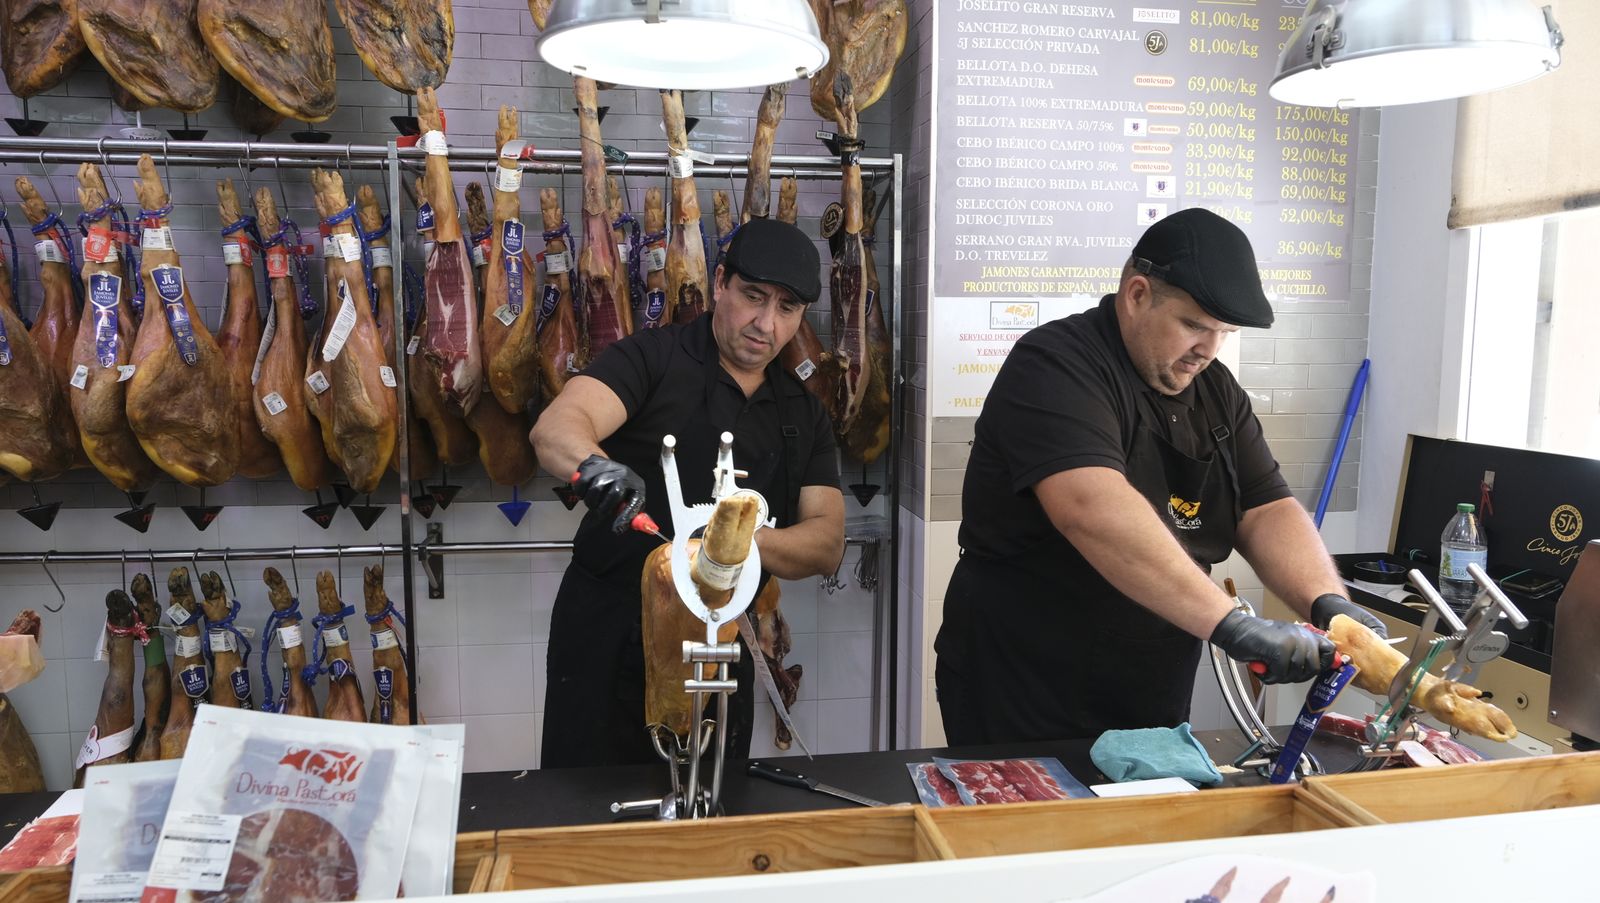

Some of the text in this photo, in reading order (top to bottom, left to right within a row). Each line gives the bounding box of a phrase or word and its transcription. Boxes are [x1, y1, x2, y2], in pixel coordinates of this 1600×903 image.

[957, 0, 1115, 18] JOSELITO GRAN RESERVA
[1190, 11, 1260, 31] 81,00€/kg
[957, 22, 1139, 41] SANCHEZ ROMERO CARVAJAL
[957, 38, 1100, 54] 5J SELECCIÓN PRIVADA
[1189, 38, 1259, 58] 81,00€/kg
[957, 60, 1098, 75] BELLOTA D.O. DEHESA
[957, 75, 1054, 88] EXTREMADURA
[1188, 76, 1257, 96] 69,00€/kg
[957, 95, 1144, 112] BELLOTA 100% EXTREMADURA
[1187, 102, 1256, 121] 59,00€/kg
[957, 116, 1114, 131] BELLOTA RESERVA 50/75%
[1275, 106, 1349, 125] 175,00€/kg
[1186, 123, 1256, 142] 50,00€/kg
[1275, 127, 1348, 146] 150,00€/kg
[957, 136, 1125, 153] CEBO IBÉRICO CAMPO 100%
[1186, 144, 1255, 162] 33,90€/kg
[957, 156, 1118, 171] CEBO IBÉRICO CAMPO 50%
[1281, 147, 1347, 166] 92,00€/kg
[1185, 163, 1254, 181] 31,90€/kg
[1281, 167, 1347, 185] 88,00€/kg
[956, 176, 1139, 192] CEBO IBÉRICO BRIDA BLANCA
[1185, 181, 1254, 199] 21,90€/kg
[1280, 185, 1346, 203] 69,00€/kg
[956, 198, 1113, 212] SELECCIÓN CORONA ORO
[956, 215, 1054, 226] DUROC JUVILES
[1280, 208, 1344, 227] 52,00€/kg
[956, 235, 1133, 248] SERRANO GRAN RVA. JUVILES
[1278, 241, 1343, 259] 36,90€/kg
[955, 250, 1048, 261] D.O. TREVELEZ
[981, 267, 1029, 278] JAMONES
[1031, 267, 1110, 278] GARANTIZADOS
[1270, 269, 1312, 281] MEJORES
[963, 281, 1039, 293] PRODUCTORES
[1041, 282, 1054, 293] DE
[1057, 279, 1098, 294] ESPAÑA,
[1276, 284, 1328, 295] CUCHILLO.
[960, 333, 993, 341] SERVICIO
[994, 333, 1003, 341] DE
[1556, 513, 1574, 533] 5J
[1527, 538, 1561, 555] Cinco
[236, 772, 356, 803] Divina Pastora
